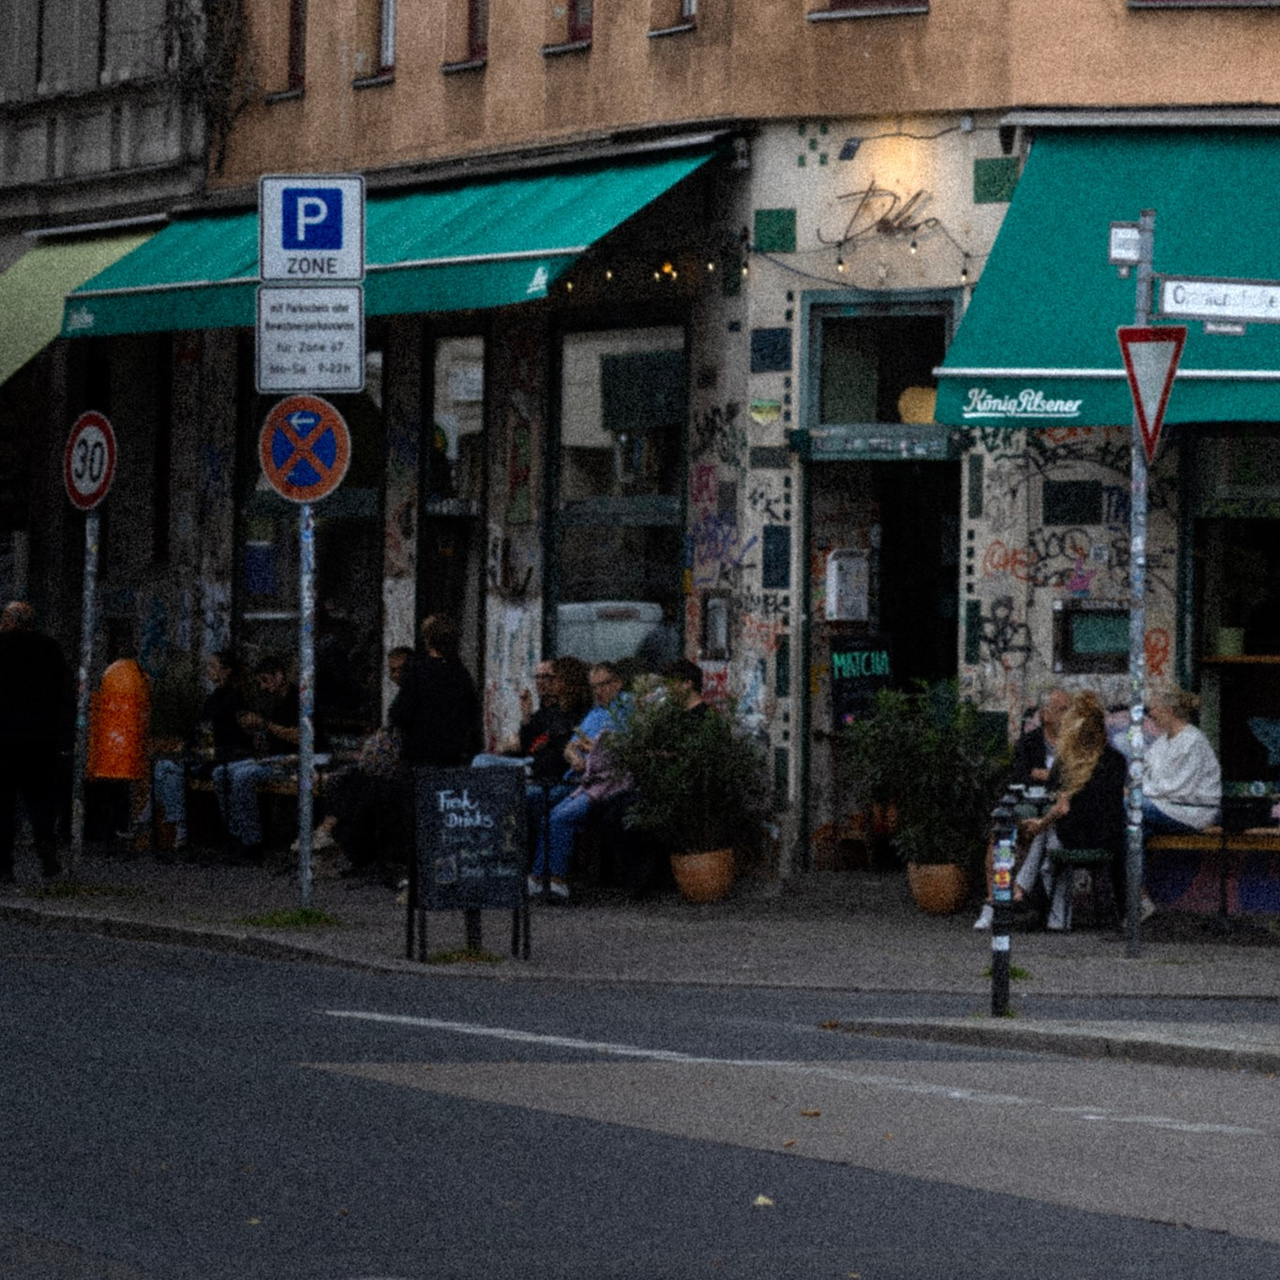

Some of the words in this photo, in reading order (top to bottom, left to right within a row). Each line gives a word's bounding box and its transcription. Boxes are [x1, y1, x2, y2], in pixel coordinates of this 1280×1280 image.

[297, 197, 327, 241] P
[287, 257, 338, 274] ZONE
[962, 387, 1020, 417] König
[1018, 388, 1082, 414] Pilsener
[75, 438, 104, 482] 30
